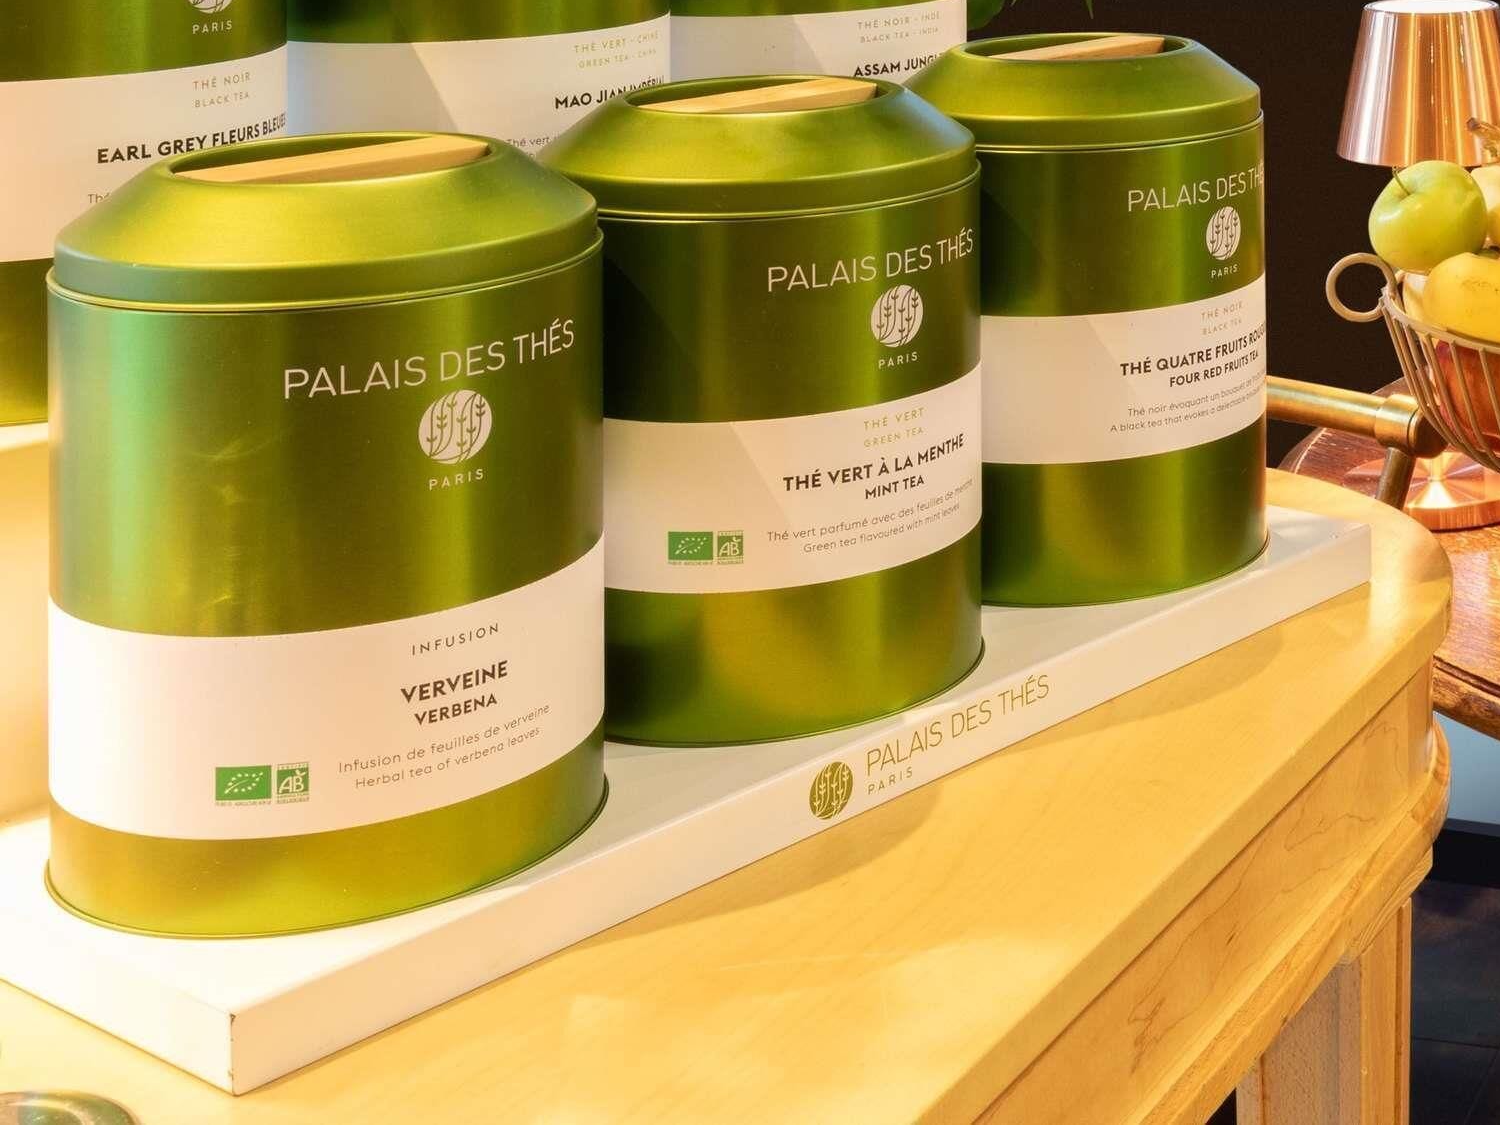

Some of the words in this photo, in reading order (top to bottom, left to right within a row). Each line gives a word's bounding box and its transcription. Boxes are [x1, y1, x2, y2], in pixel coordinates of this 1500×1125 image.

[192, 20, 233, 34] PARIS
[860, 34, 890, 43] BLACK
[602, 38, 626, 50] VERT
[854, 61, 900, 77] ASSAM
[905, 53, 942, 71] JUNG
[193, 78, 216, 91] THÉ
[224, 72, 251, 85] NOIR
[194, 96, 230, 108] BLACK
[234, 91, 250, 101] TEA
[555, 92, 592, 110] MAO
[98, 144, 151, 164] EARL
[158, 135, 207, 156] GREY
[212, 123, 260, 147] FLEURS
[1128, 181, 1211, 212] PALAIS
[1216, 171, 1246, 200] DES
[767, 255, 877, 292] PALAIS
[886, 244, 932, 278] DES
[936, 227, 973, 265] THÉS
[1211, 264, 1238, 278] PARIS
[284, 356, 427, 399] PALAIS
[440, 341, 505, 382] DES
[513, 317, 574, 364] THÉS
[878, 351, 919, 370] PARIS
[1120, 357, 1151, 376] THÉ
[1156, 348, 1212, 370] QUATRE
[1215, 335, 1248, 359] FRUITS
[1169, 371, 1200, 387] FOUR
[1203, 365, 1222, 380] RED
[1224, 353, 1248, 374] FRUITS
[863, 415, 888, 431] THÉ
[895, 407, 925, 424] VERT
[1128, 406, 1145, 416] Thé
[1148, 405, 1167, 414] noir
[1169, 395, 1208, 411] évoquant
[1120, 421, 1145, 431] black
[1148, 419, 1162, 427] tea
[1165, 415, 1182, 425] that
[863, 433, 901, 448] GREEN
[905, 426, 925, 441] TEA
[783, 469, 822, 491] THÉ
[828, 464, 873, 484] VERT
[878, 457, 890, 476] À
[894, 455, 914, 473] LA
[917, 432, 964, 465] MENTHE
[429, 468, 484, 491] PARIS
[865, 481, 899, 500] MINT
[903, 474, 925, 492] TEA
[767, 530, 789, 542] Thé
[793, 528, 816, 539] vert
[820, 518, 868, 537] parfumé
[871, 512, 896, 525] avec
[898, 507, 914, 518] des
[917, 496, 944, 512] feuilles
[803, 540, 837, 553] Green
[839, 536, 856, 547] tea
[860, 525, 905, 543] flavoured
[906, 520, 923, 531] with
[925, 511, 940, 524] mint
[411, 623, 500, 656] INFUSION
[400, 660, 508, 703] VERVEINE
[414, 692, 498, 726] VERBENA
[339, 755, 401, 774] Infusion
[407, 748, 425, 760] de
[430, 732, 480, 754] feuilles
[484, 725, 500, 738] de
[504, 705, 550, 731] verveine
[866, 721, 943, 777] PALAIS
[951, 700, 992, 738] DES
[998, 675, 1049, 716] THÉS
[355, 770, 404, 788] Herbal
[410, 765, 432, 778] tea
[437, 759, 450, 770] of
[454, 742, 504, 766] verbena
[507, 727, 540, 747] leaves
[279, 775, 304, 793] AB
[867, 766, 914, 795] PARIS
